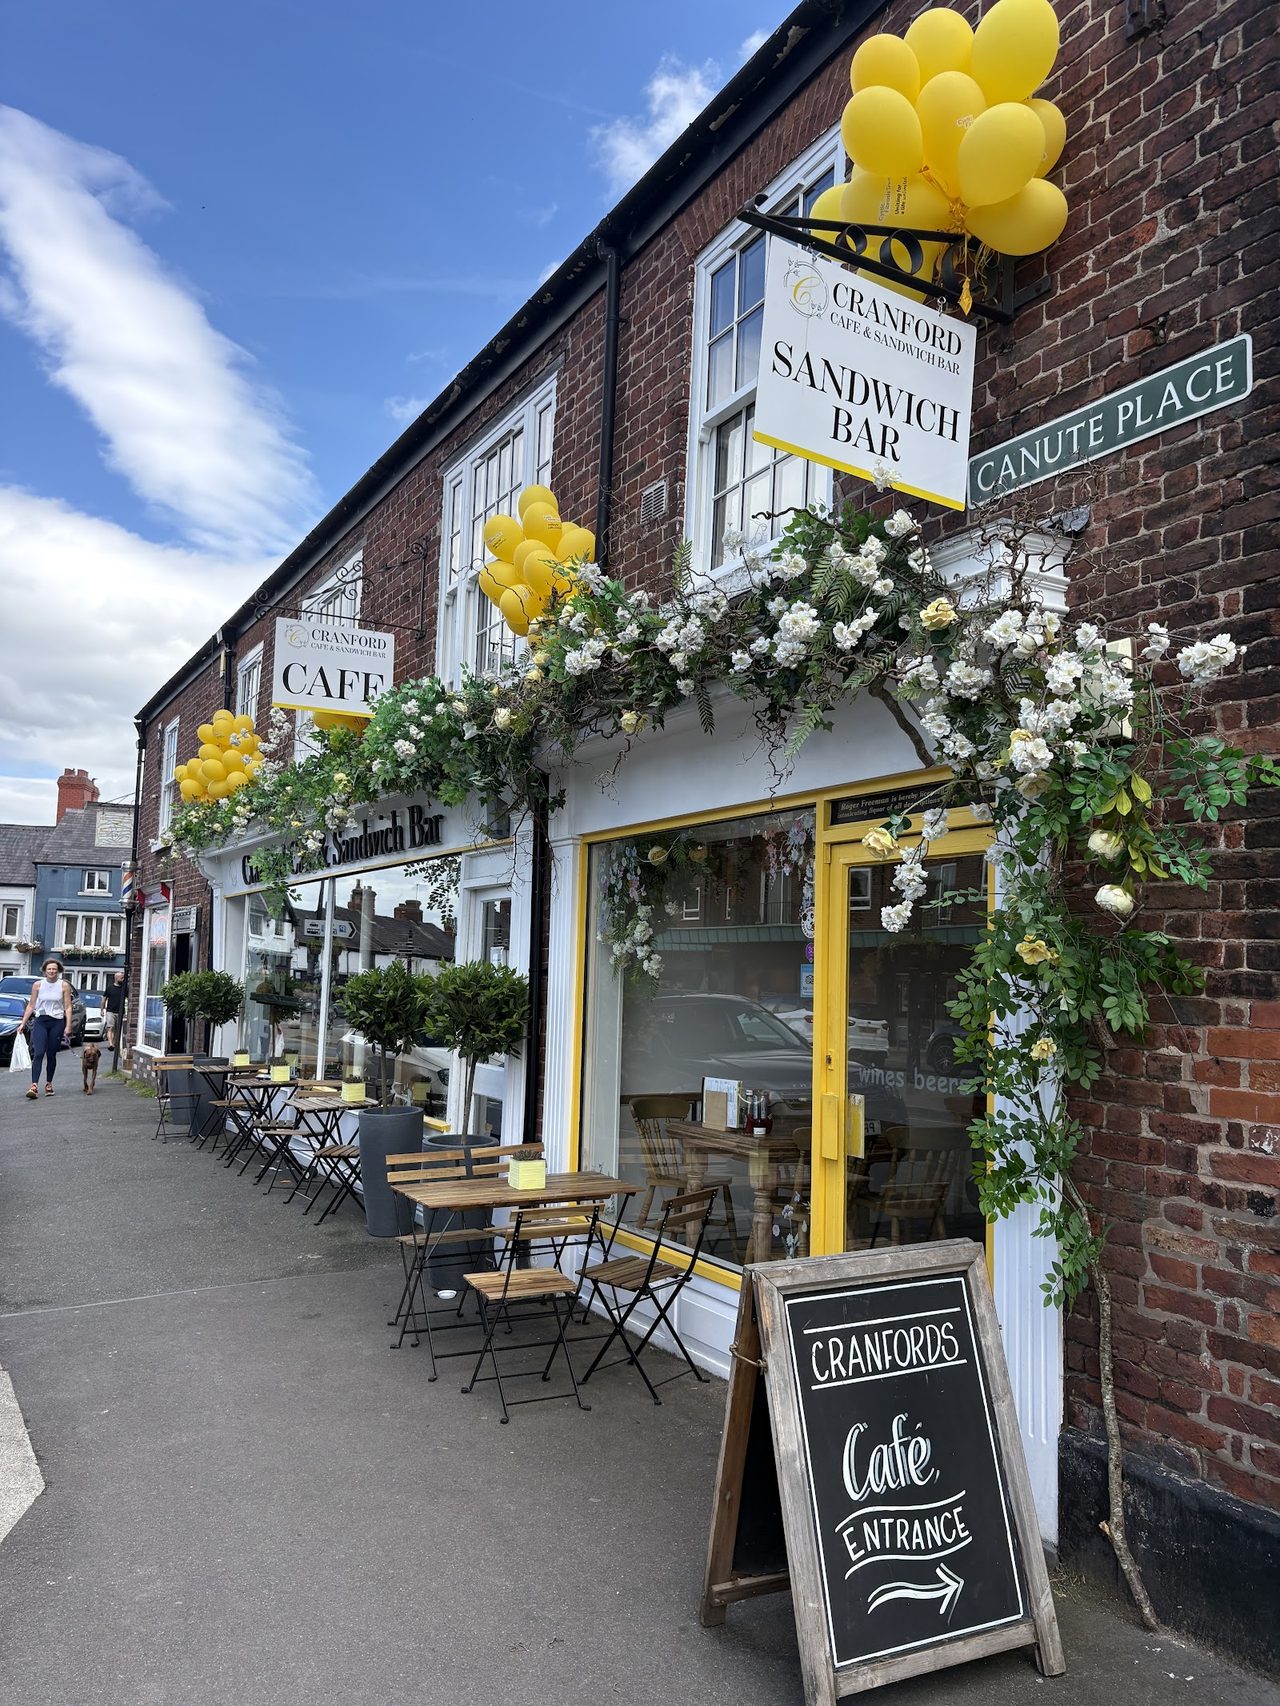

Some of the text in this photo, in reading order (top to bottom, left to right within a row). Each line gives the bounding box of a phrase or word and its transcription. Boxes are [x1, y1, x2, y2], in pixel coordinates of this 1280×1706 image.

[829, 311, 960, 376] CAFE & SANDWICH BAR
[832, 282, 962, 356] CRANFORD
[772, 340, 961, 443] SANDWICH
[829, 404, 901, 463] BAR
[976, 354, 1235, 492] CANUTE PLACE
[310, 642, 329, 652] CAFE
[335, 645, 373, 657] SANDWICH
[373, 651, 386, 659] BAR
[311, 628, 387, 651] CRANFORD
[840, 801, 860, 812] Roger
[861, 797, 890, 808] Freeman
[891, 795, 897, 803] is
[898, 791, 919, 802] hereby
[332, 809, 405, 866] Sandwich
[408, 804, 445, 849] Bar
[860, 1062, 905, 1088] wines
[811, 1321, 959, 1382] CRANFORDS
[843, 1505, 972, 1562] ENTRANCE
